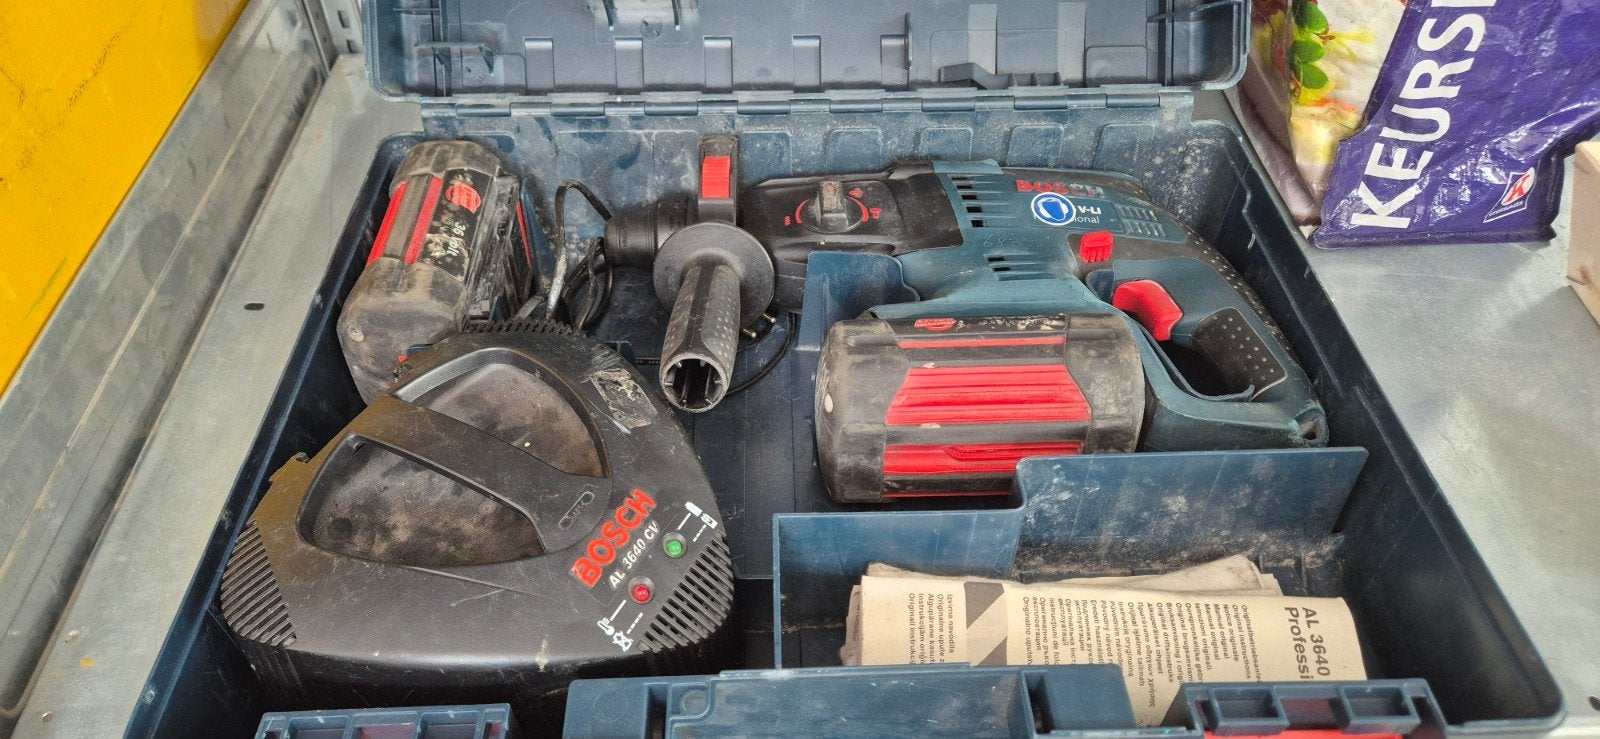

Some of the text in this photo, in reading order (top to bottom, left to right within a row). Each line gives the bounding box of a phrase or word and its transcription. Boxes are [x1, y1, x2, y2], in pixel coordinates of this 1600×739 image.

[1016, 179, 1105, 198] BOSCH
[453, 221, 466, 237] 36
[570, 488, 657, 588] BOSCH
[608, 519, 661, 590] AL 3640 CV
[927, 594, 935, 639] Algupärane
[1023, 597, 1032, 635] Originalno
[1091, 600, 1100, 623] Eredeti
[1128, 603, 1137, 626] Orijinal
[1147, 603, 1159, 647] Alkuperäiset
[1166, 603, 1181, 658] Bruksanvisning
[1176, 603, 1185, 630] Original
[1195, 603, 1212, 670] Istruzioni originali
[1204, 604, 1220, 660] Manual original
[1214, 604, 1230, 658] Manual original
[1223, 604, 1239, 661] Notice originale
[1053, 641, 1058, 649] de
[1157, 603, 1174, 683] Original driftsinstruks
[1232, 605, 1251, 679] Original instructions
[1285, 607, 1313, 679] Professi
[1302, 607, 1330, 676] AL 3640
